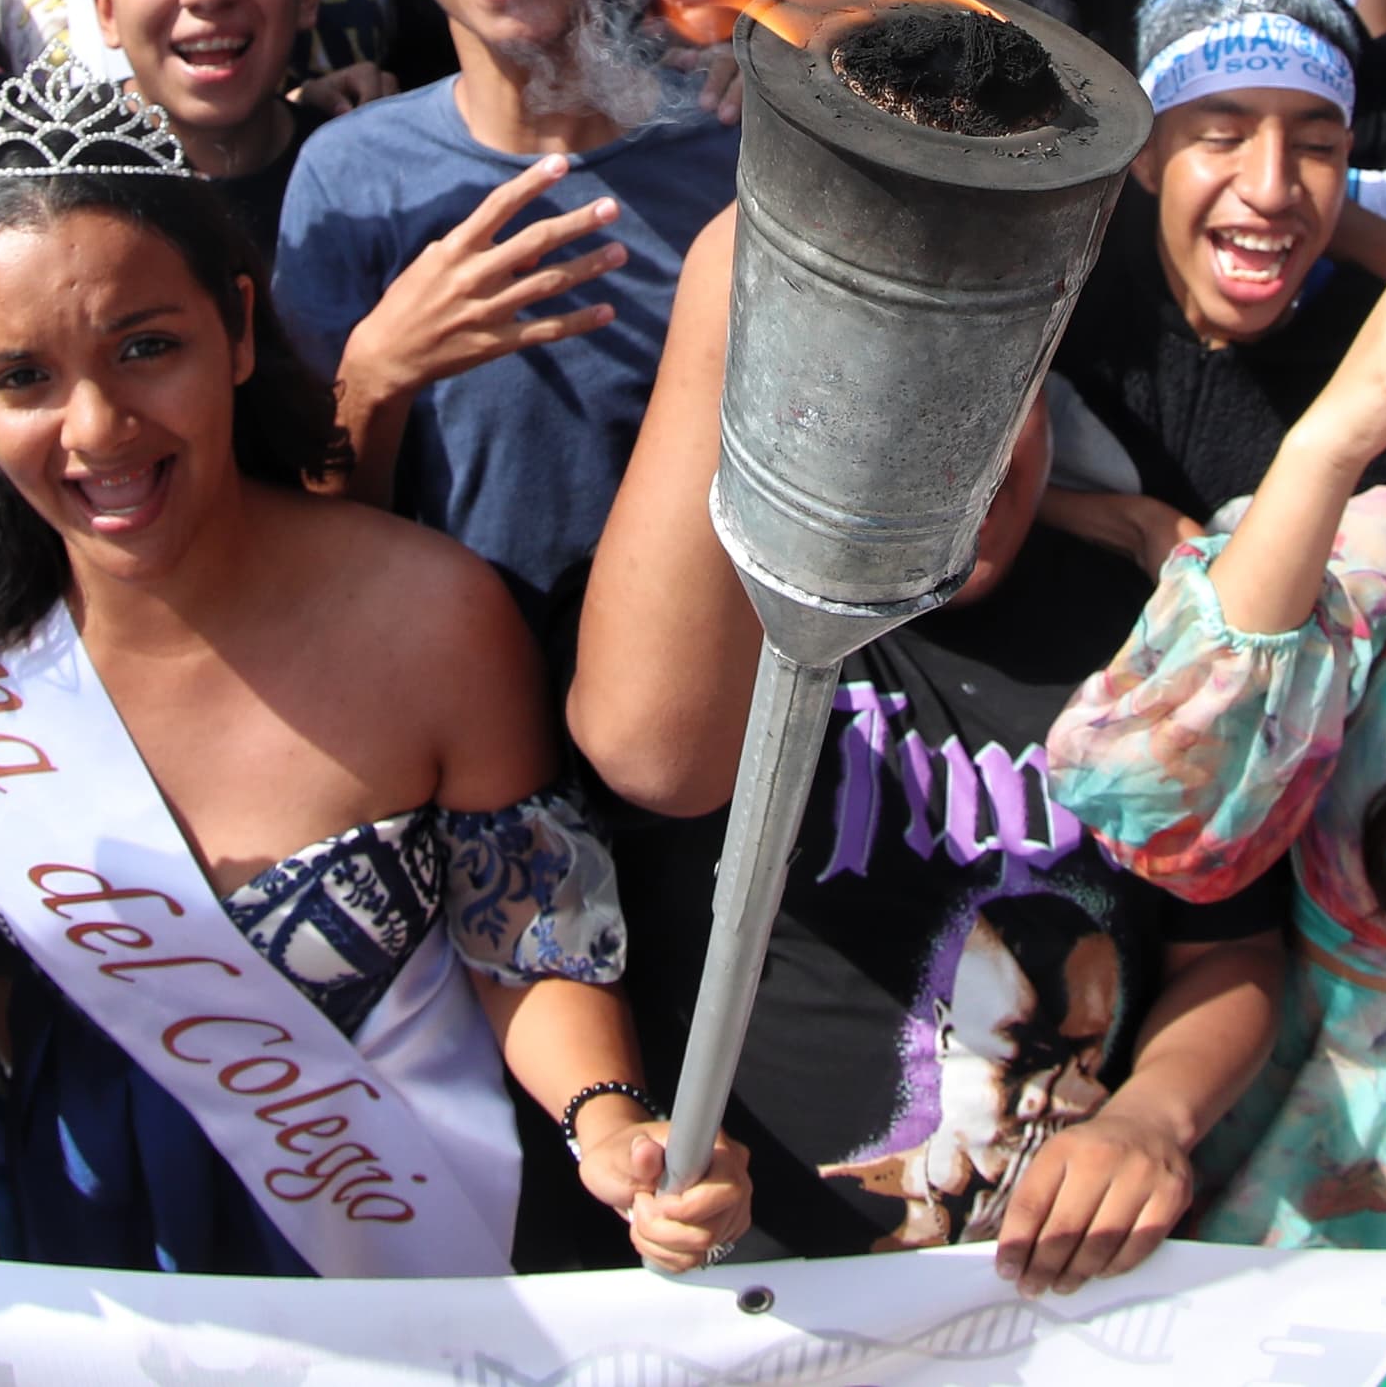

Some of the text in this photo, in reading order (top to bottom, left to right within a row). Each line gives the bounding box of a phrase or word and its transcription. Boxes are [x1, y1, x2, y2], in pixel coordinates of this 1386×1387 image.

[1225, 55, 1290, 74] SOY
[28, 863, 242, 983] del
[161, 1015, 427, 1223] Colegio
